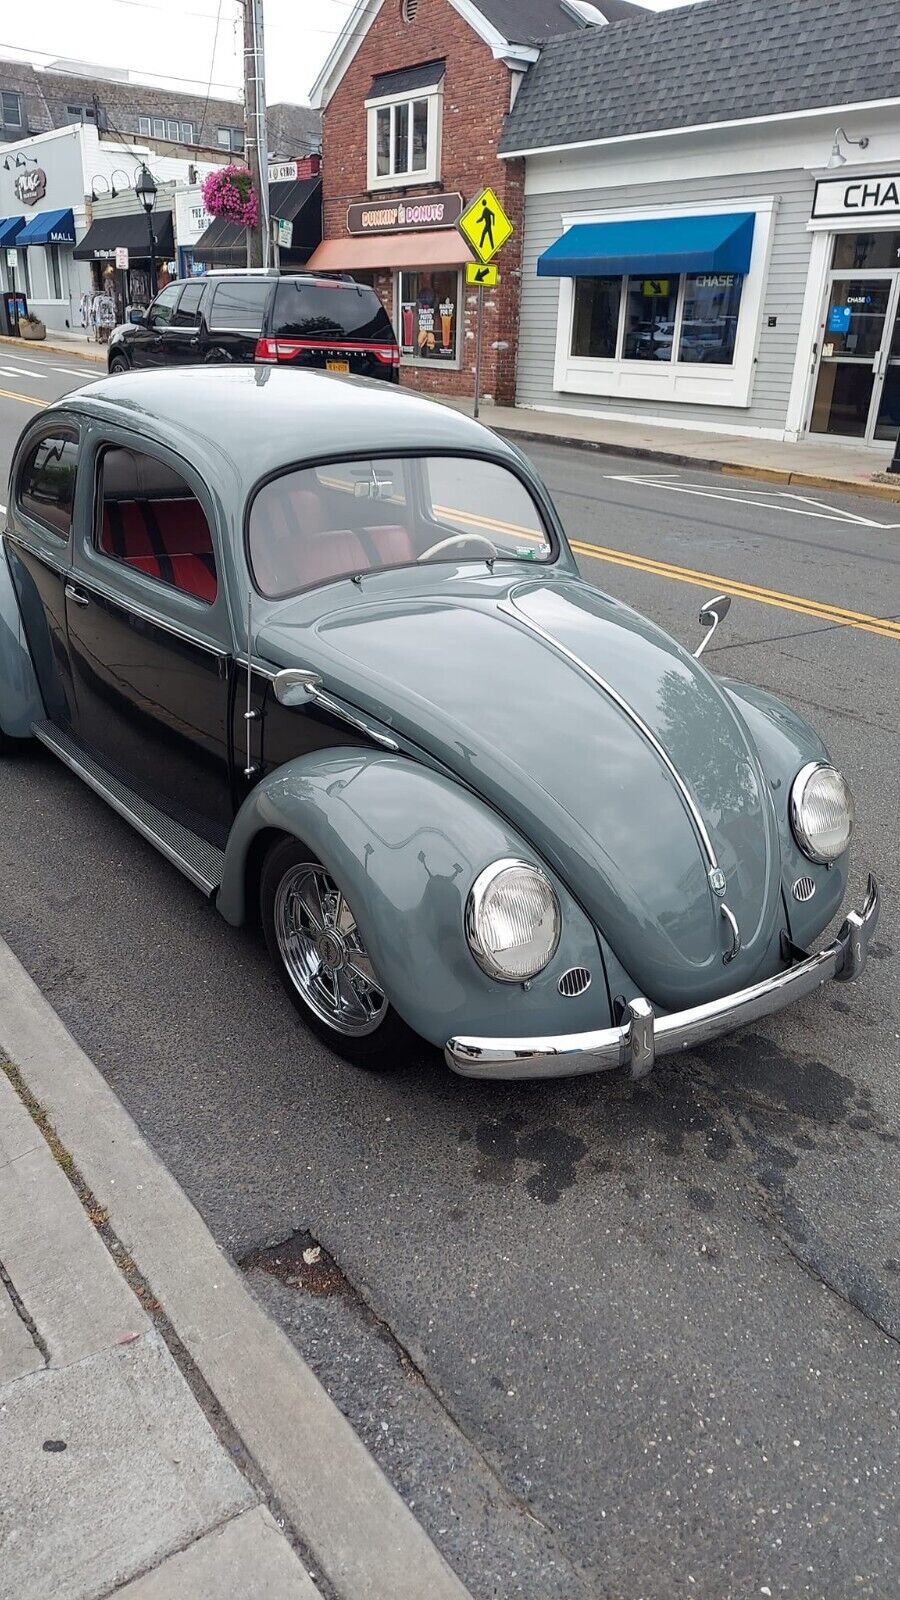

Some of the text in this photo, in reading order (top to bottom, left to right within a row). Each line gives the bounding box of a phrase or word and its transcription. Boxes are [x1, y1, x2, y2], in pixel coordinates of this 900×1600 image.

[362, 203, 444, 227] DUNKIN' DONUTS
[51, 232, 74, 241] MALL
[695, 275, 734, 287] CHASE
[847, 296, 866, 304] CHASE
